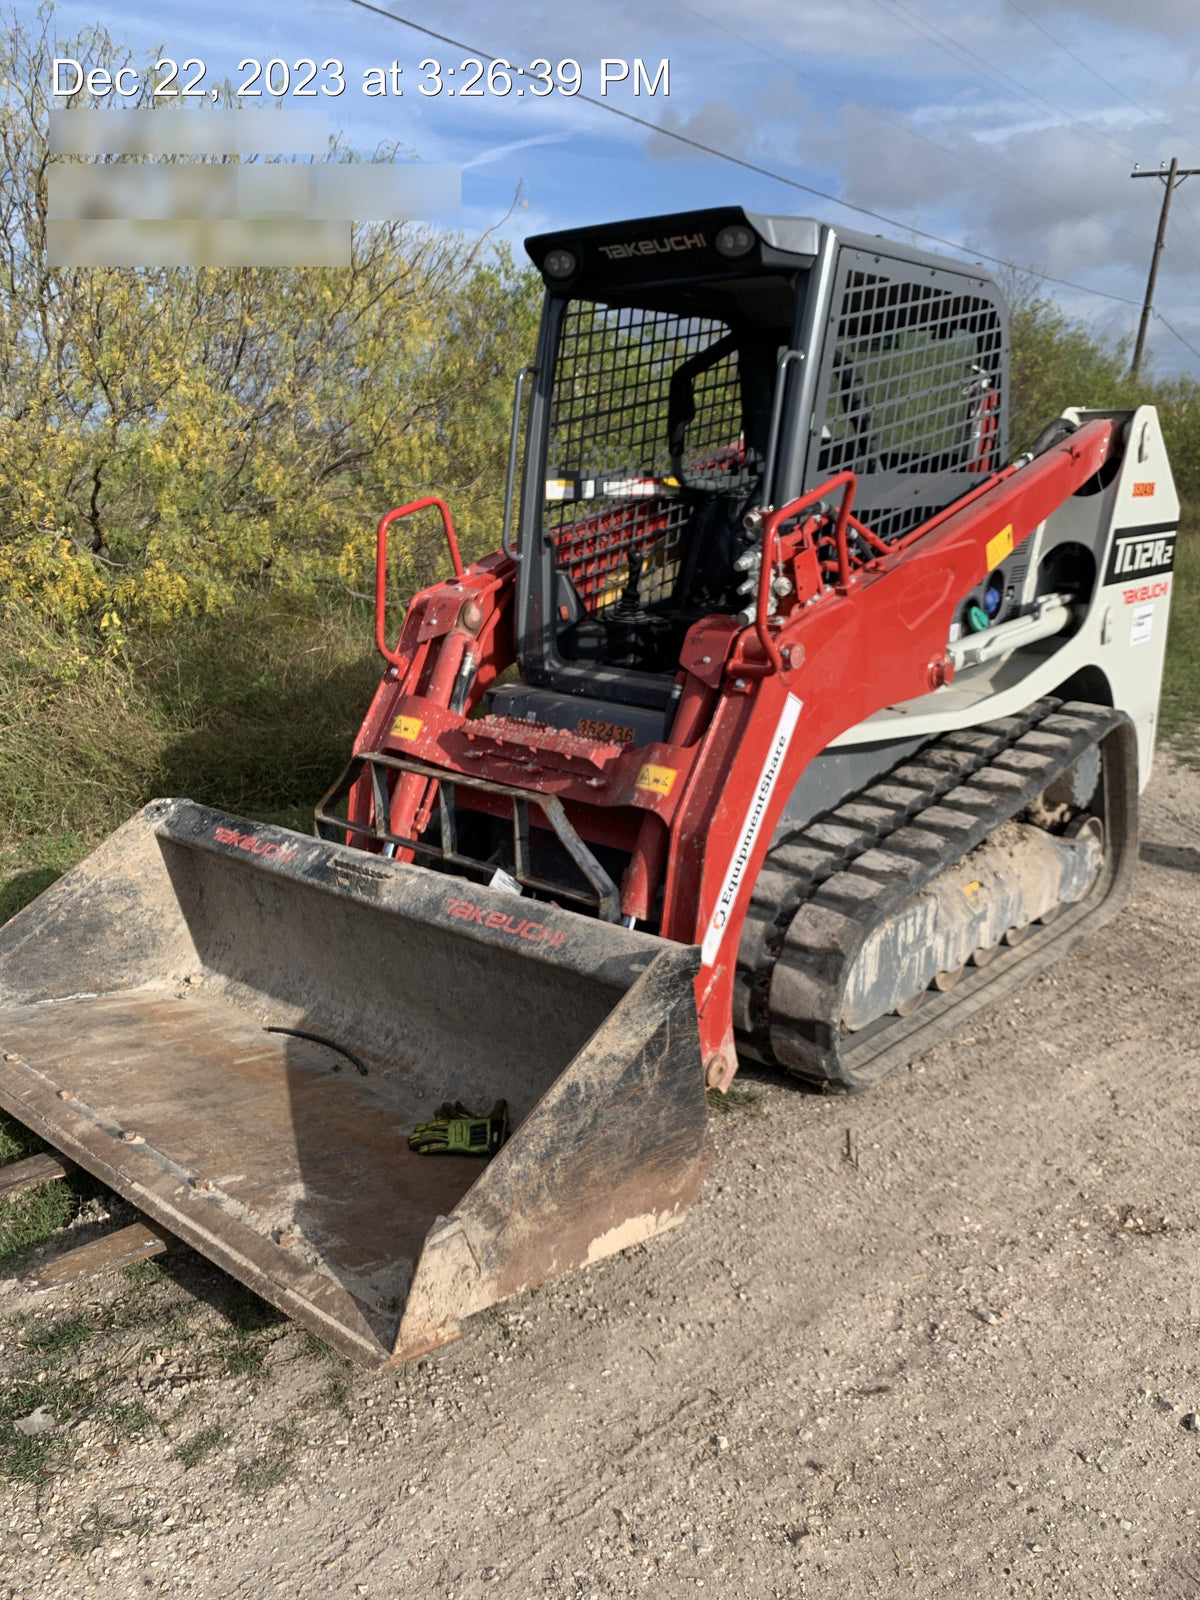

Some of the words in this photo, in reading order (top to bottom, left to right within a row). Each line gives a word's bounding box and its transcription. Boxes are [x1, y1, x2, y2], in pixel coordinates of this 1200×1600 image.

[598, 233, 707, 260] TAKEUCHI
[1122, 581, 1169, 606] TAKEUCHI
[578, 719, 635, 742] 352436
[721, 735, 787, 906] EquipmentShare
[446, 897, 569, 948] TAKEUCHI
